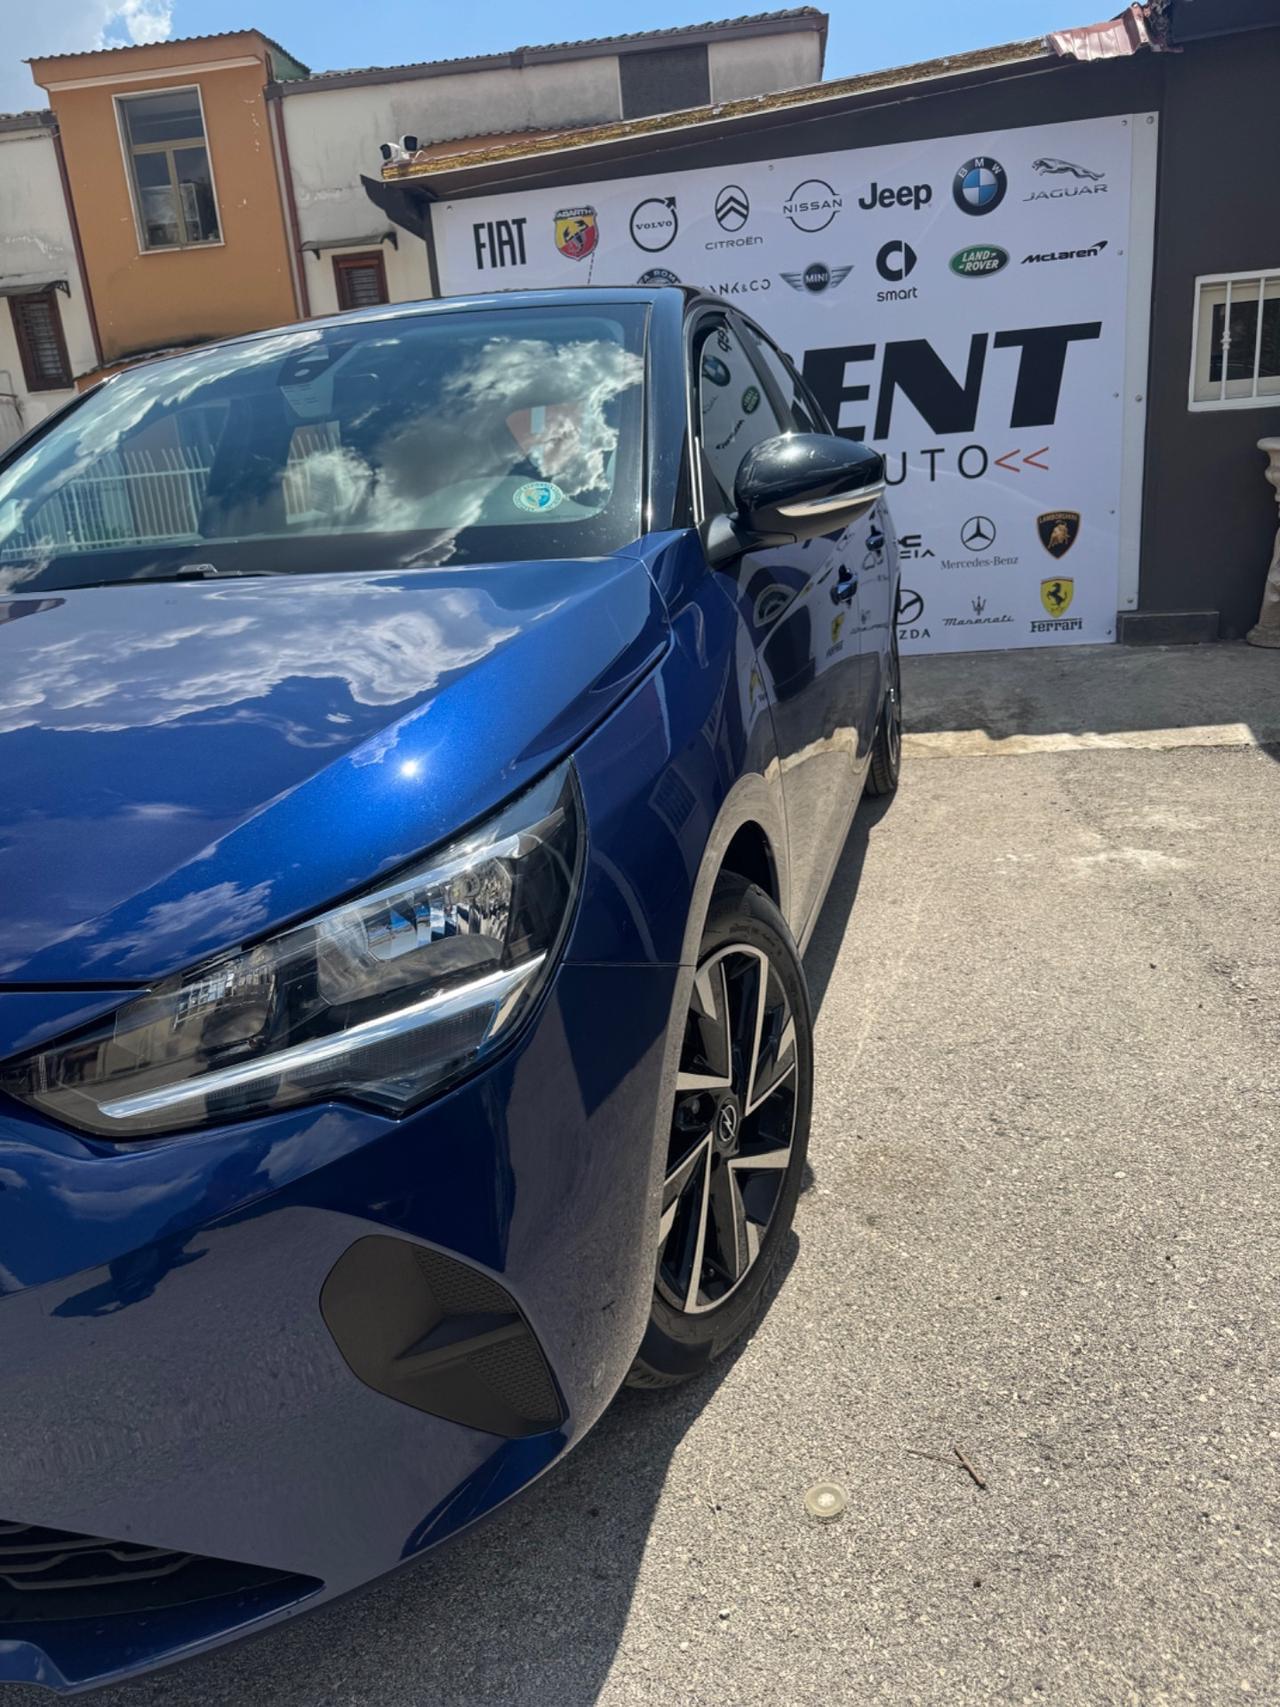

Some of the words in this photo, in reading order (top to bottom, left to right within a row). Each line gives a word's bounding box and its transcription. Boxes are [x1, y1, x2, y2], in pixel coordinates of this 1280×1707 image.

[858, 182, 932, 211] Jeep
[1022, 183, 1108, 202] JAGUAR
[783, 198, 842, 214] NISSAN
[635, 218, 673, 230] VOLVO
[472, 217, 527, 270] FIAT
[805, 272, 828, 283] MINI
[876, 286, 918, 302] smart
[794, 321, 1102, 442] ENT
[882, 444, 988, 486] UTO
[940, 556, 1019, 570] Mercedes-Benz
[1029, 618, 1082, 633] Ferrari
[898, 629, 931, 640] ZDA
